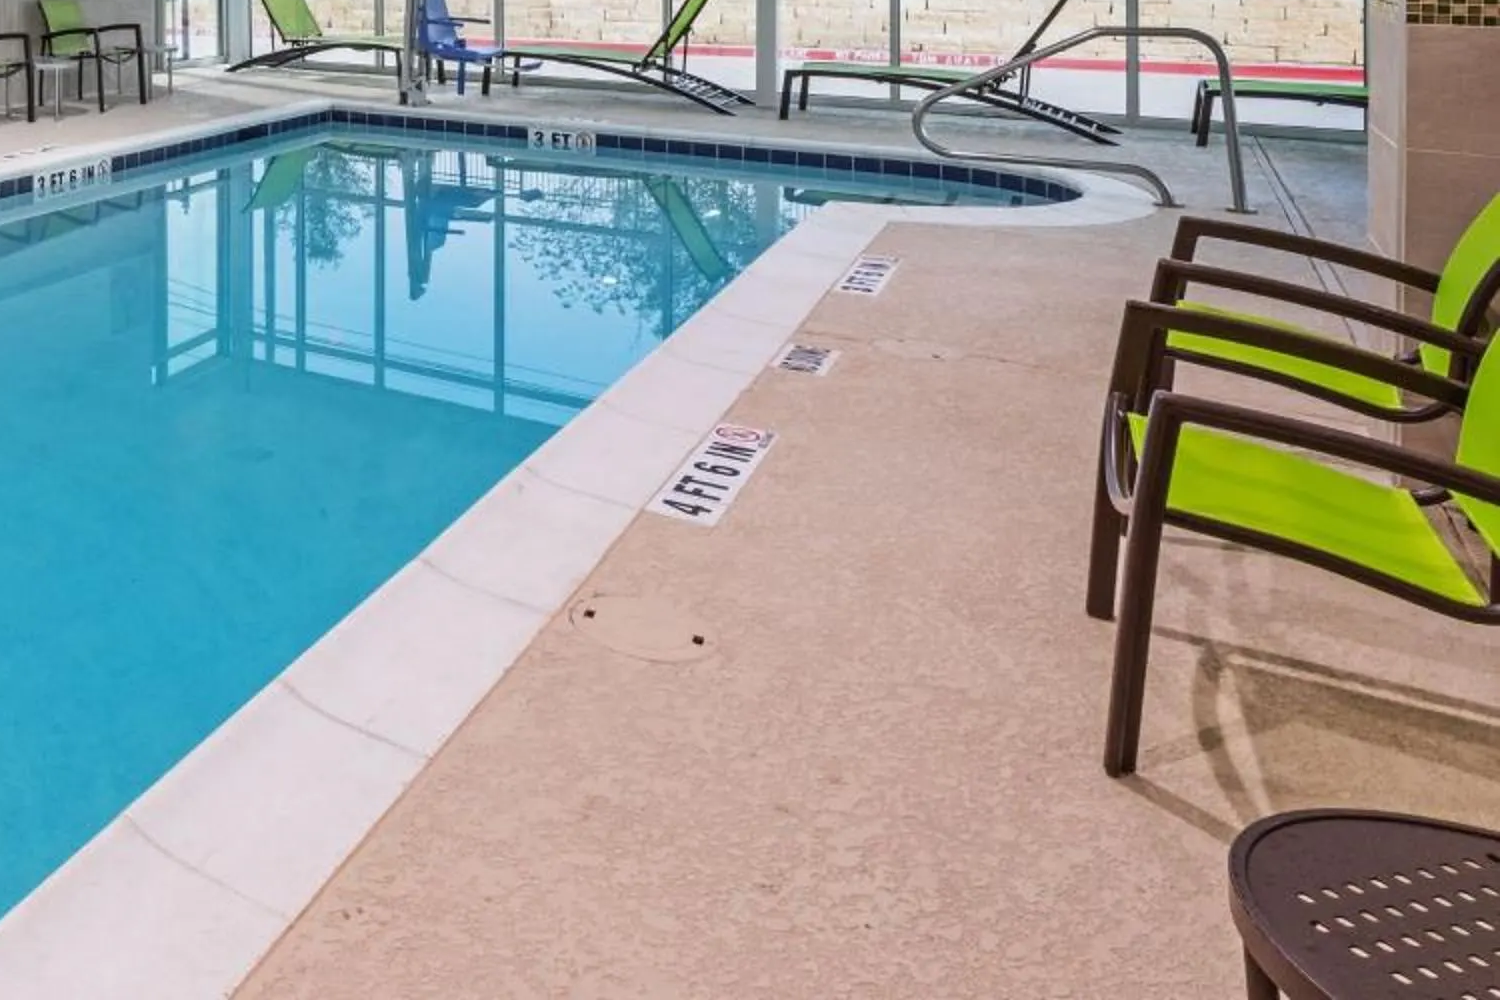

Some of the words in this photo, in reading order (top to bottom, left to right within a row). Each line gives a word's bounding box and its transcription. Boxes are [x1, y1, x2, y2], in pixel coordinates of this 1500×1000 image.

[704, 441, 757, 463] IN
[693, 461, 741, 477] 6
[672, 475, 730, 501] FT
[662, 499, 713, 516] 4
